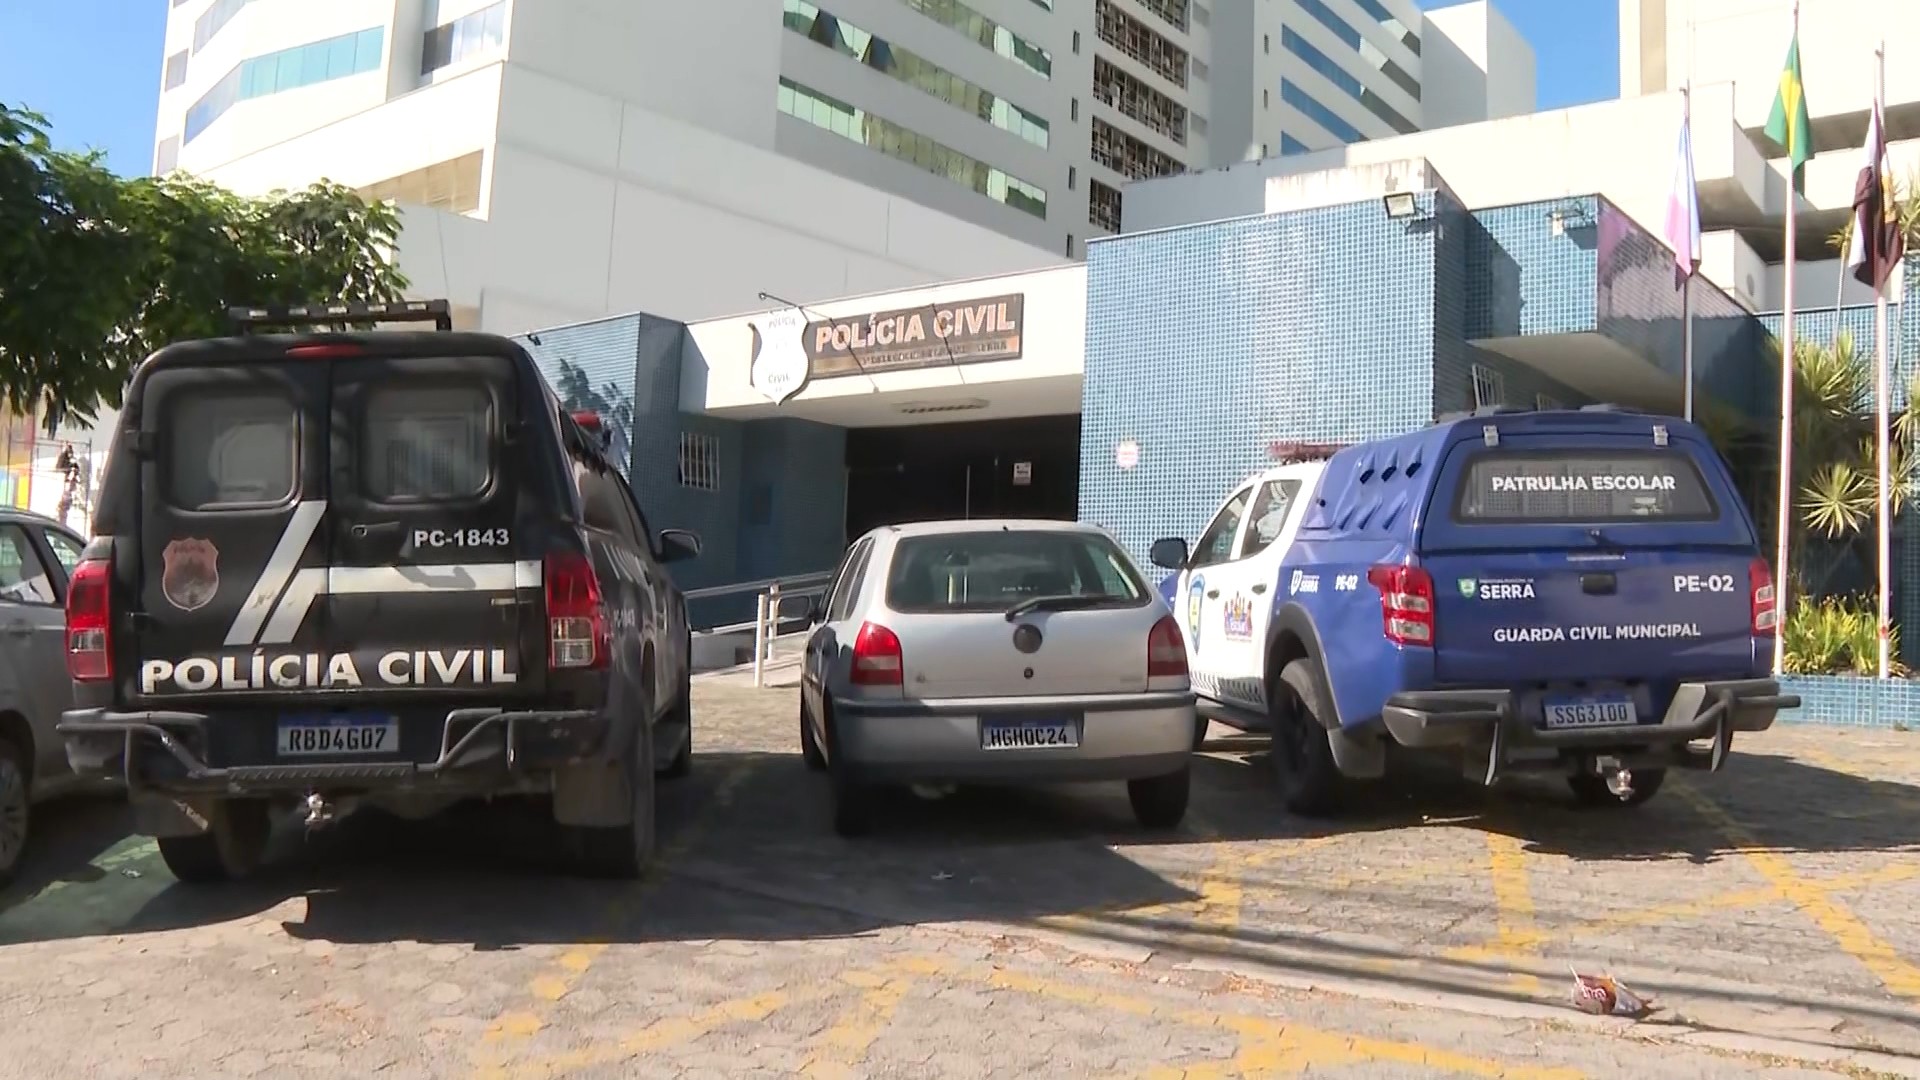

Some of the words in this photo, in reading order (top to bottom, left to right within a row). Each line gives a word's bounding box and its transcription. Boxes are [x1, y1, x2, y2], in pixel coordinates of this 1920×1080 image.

[815, 311, 926, 353] POLÍCIA
[933, 302, 1015, 338] CIVIL
[1492, 476, 1588, 492] PATRULHA
[1592, 475, 1676, 491] ESCOLAR
[413, 528, 510, 548] PC-1843
[1480, 584, 1535, 600] SERRA
[1674, 575, 1735, 592] PE-02
[1493, 628, 1565, 642] GUARDA
[1570, 625, 1612, 641] CIVIL
[1616, 622, 1701, 640] MUNICIPAL
[141, 648, 363, 694] POLÍCIA
[377, 649, 517, 684] CIVIL
[1554, 703, 1628, 725] SSG3100
[289, 726, 387, 752] RBD4G07
